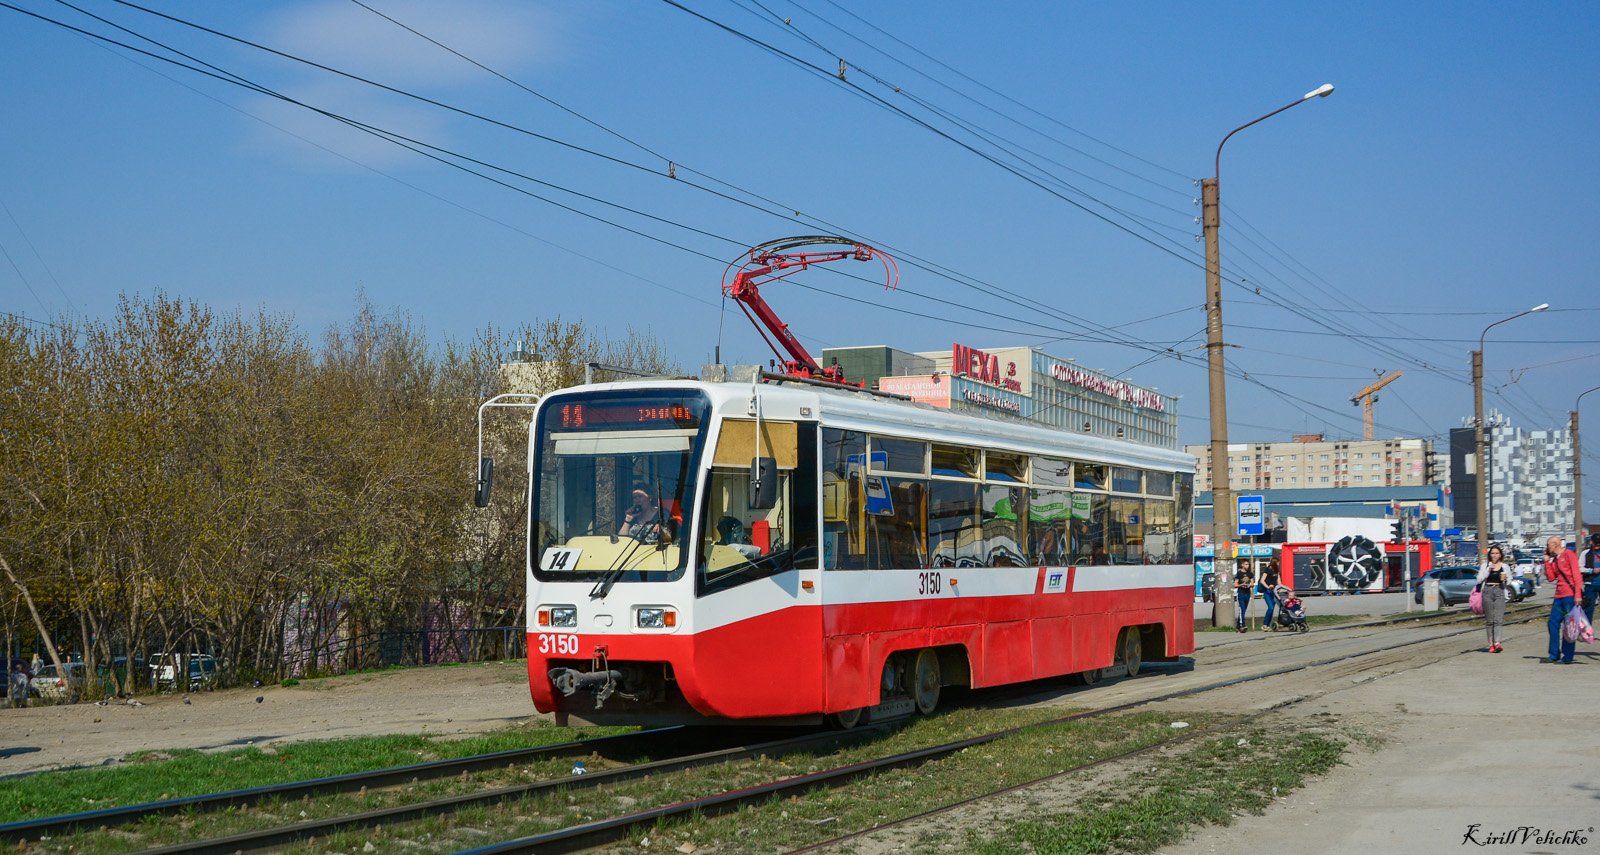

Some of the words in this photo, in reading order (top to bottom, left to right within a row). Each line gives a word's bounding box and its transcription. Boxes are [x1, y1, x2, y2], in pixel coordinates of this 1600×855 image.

[953, 342, 1000, 386] МЕХА
[549, 551, 571, 570] 14
[919, 572, 941, 595] 3150
[538, 634, 579, 655] 3150
